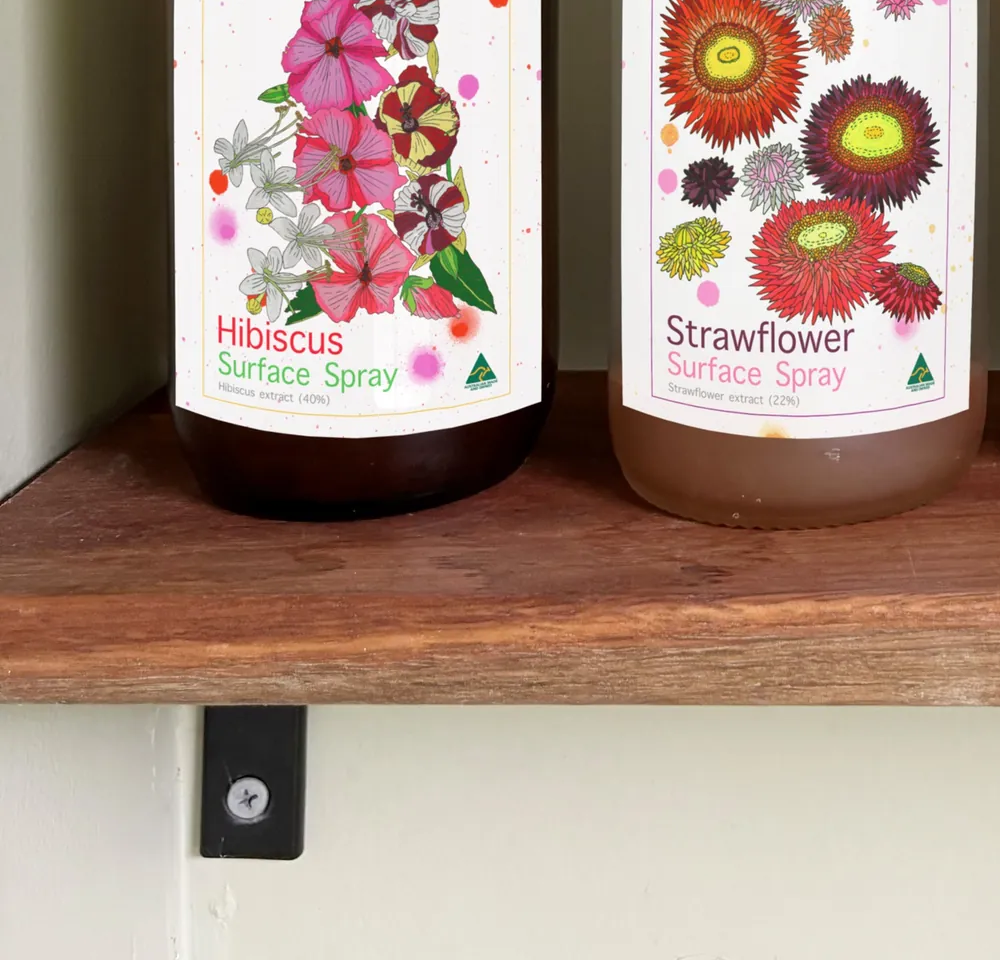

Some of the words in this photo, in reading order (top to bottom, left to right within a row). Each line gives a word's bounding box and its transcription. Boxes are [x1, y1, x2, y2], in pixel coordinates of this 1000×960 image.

[217, 315, 343, 355] Hibiscus
[667, 315, 855, 354] Strawflower
[218, 351, 310, 386] Surface
[324, 361, 398, 392] Spray
[667, 351, 762, 386] Surface
[776, 360, 847, 393] Spray
[218, 381, 256, 398] Hibiscus
[259, 389, 294, 403] extract
[298, 393, 331, 406] (40%)
[668, 381, 724, 401] Strawflower
[728, 391, 764, 405] extract
[768, 394, 800, 407] (22%)
